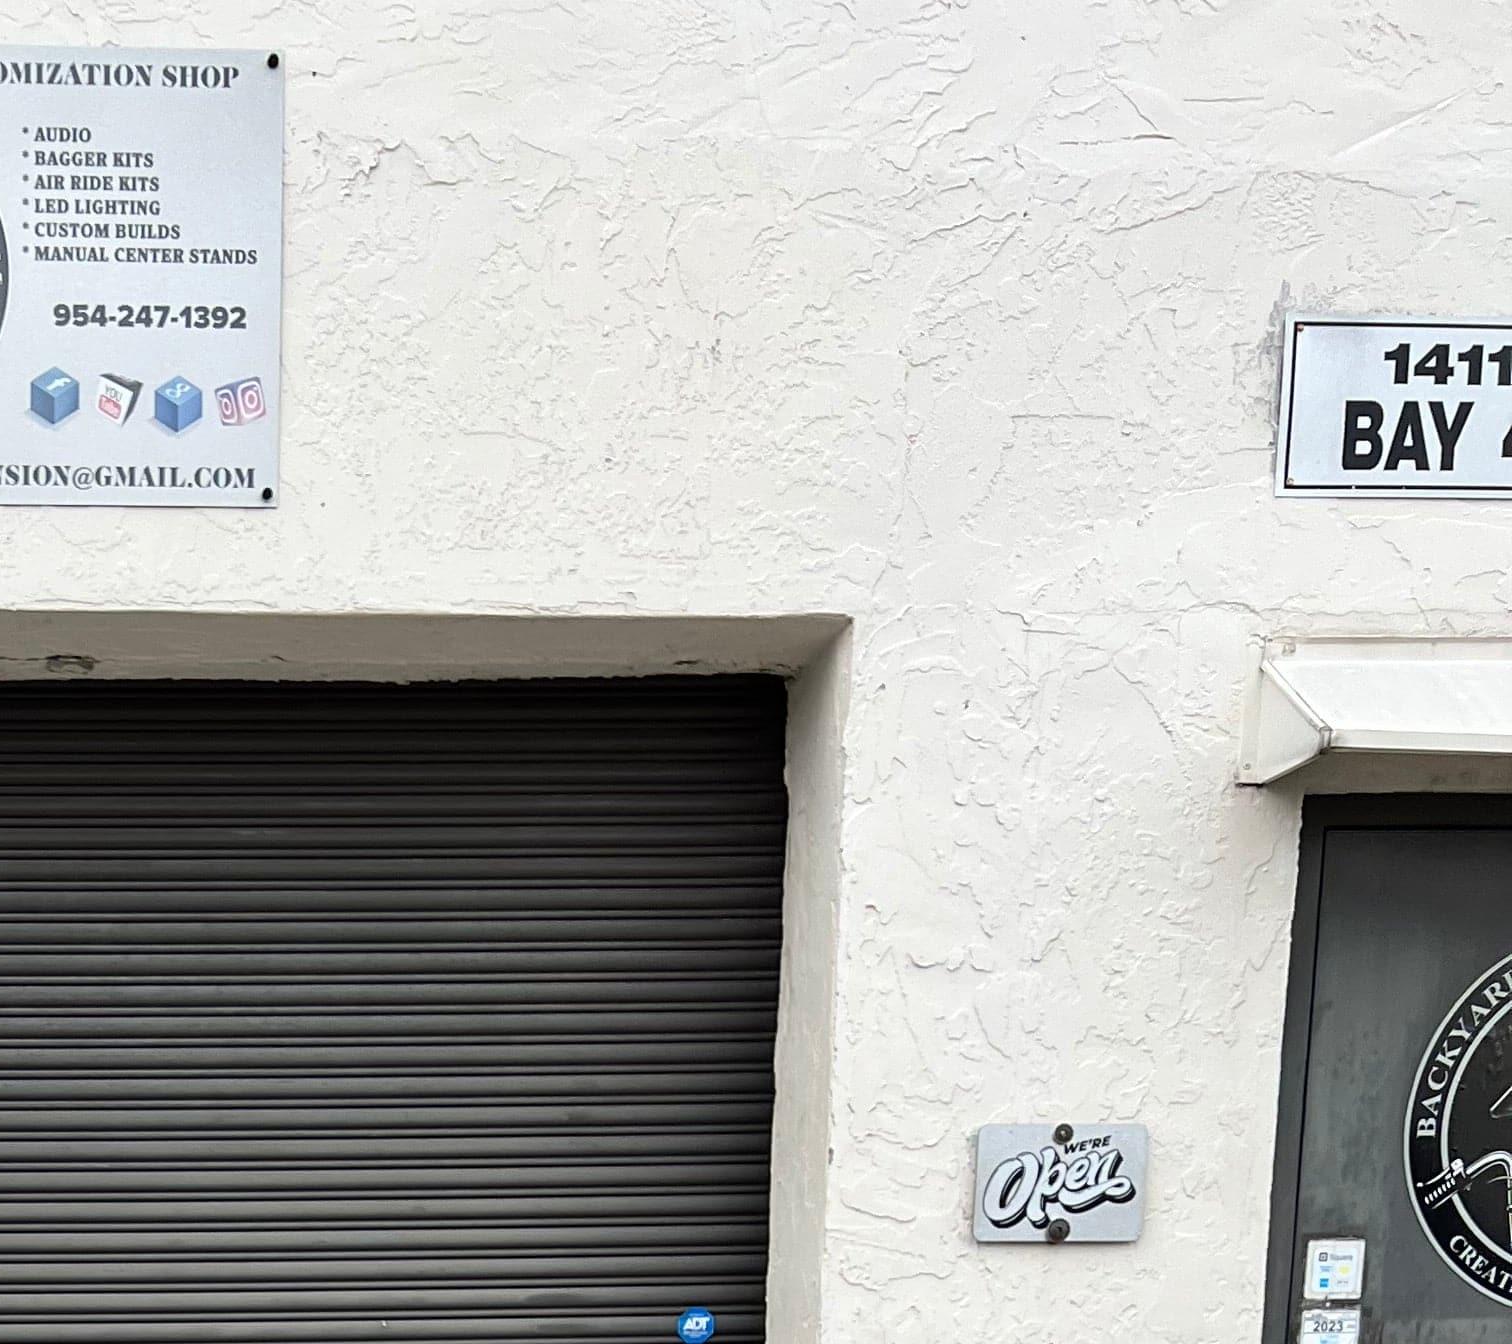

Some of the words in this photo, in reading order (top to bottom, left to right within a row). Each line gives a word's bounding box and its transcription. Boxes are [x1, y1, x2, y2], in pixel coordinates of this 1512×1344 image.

[161, 65, 240, 89] SHOP
[34, 127, 92, 144] AUDIO
[34, 151, 107, 168] BAGGER
[111, 152, 155, 168] KITS
[34, 175, 67, 192] AIR
[71, 176, 113, 192] RIDE
[116, 177, 160, 192] KITS
[34, 199, 70, 216] LED
[74, 200, 161, 216] LIGHTING
[34, 223, 109, 240] CUSTOM
[114, 224, 181, 240] BUILDS
[34, 247, 109, 263] MANUAL
[114, 248, 185, 264] CENTER
[189, 248, 258, 265] STANDS
[53, 304, 247, 330] 954-247-1392
[1384, 342, 1512, 386] 1411
[1342, 400, 1475, 471] BAY
[1063, 1135, 1113, 1154] WE'RE
[983, 1146, 1136, 1229] Open
[1449, 1235, 1512, 1293] CREAT
[683, 1316, 710, 1331] ADT
[1312, 1320, 1344, 1333] 2023
